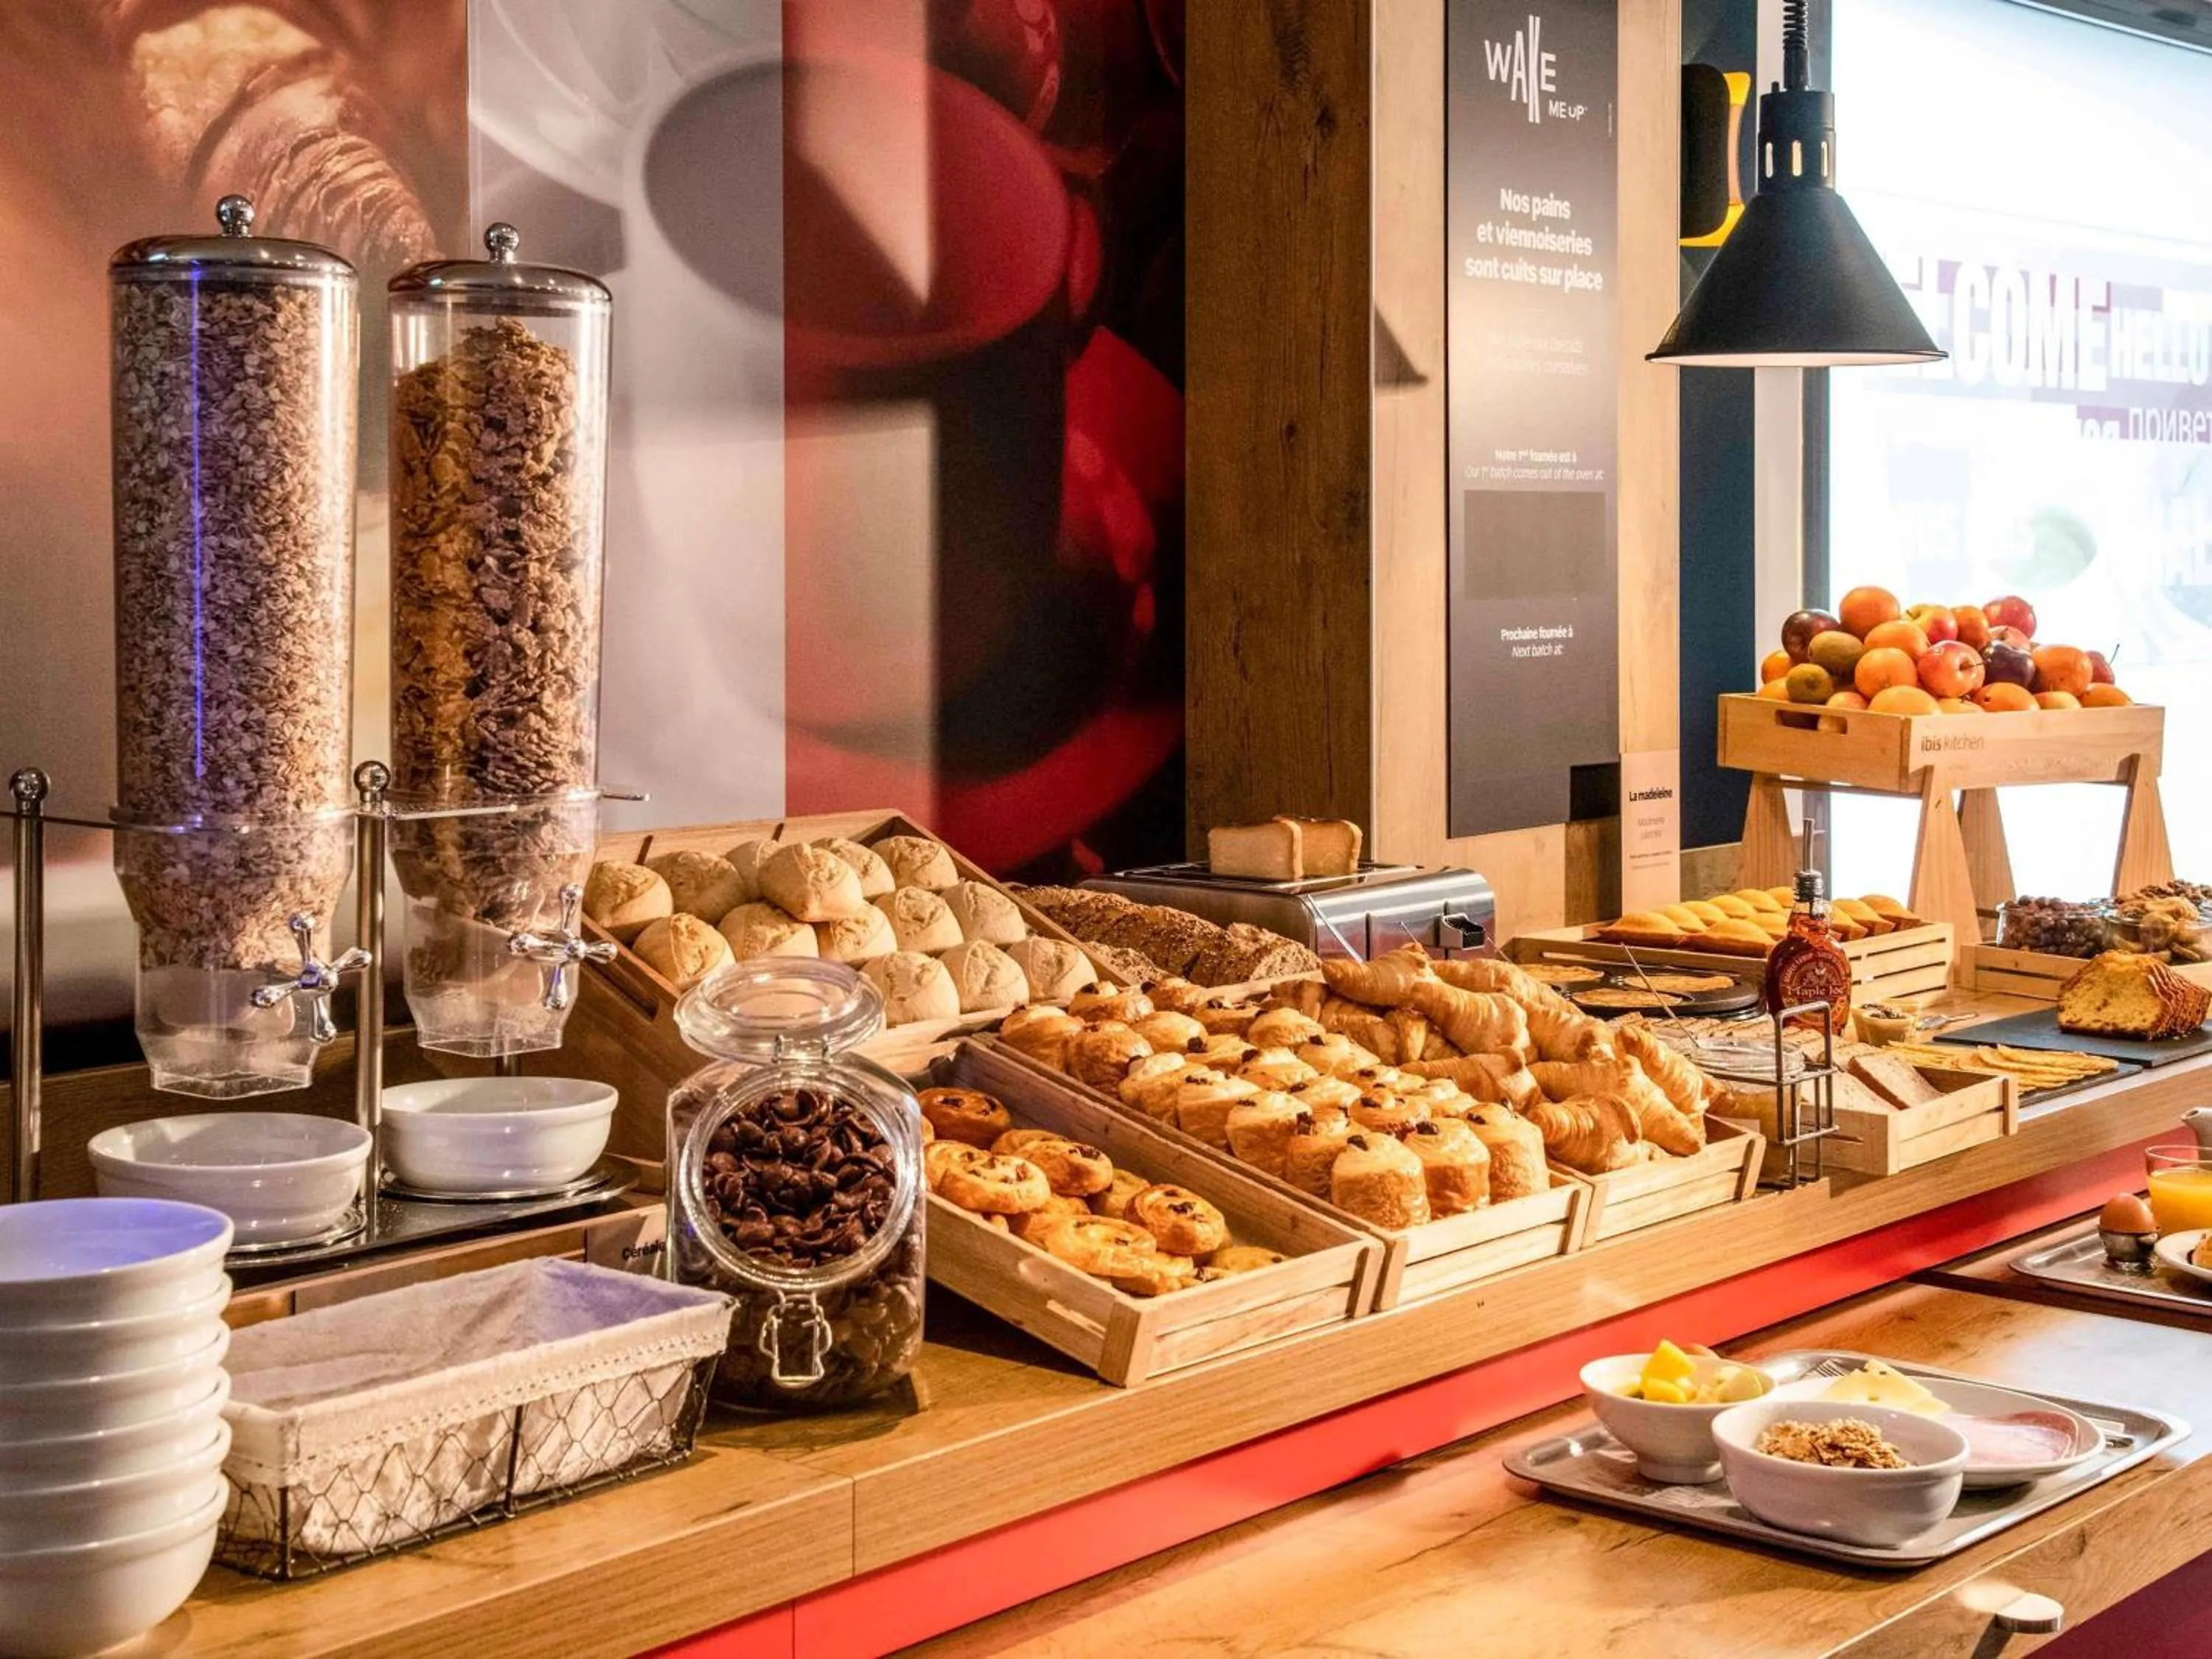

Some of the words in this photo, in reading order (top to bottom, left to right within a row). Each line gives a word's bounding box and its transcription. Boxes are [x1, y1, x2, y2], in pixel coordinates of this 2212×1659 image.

[1484, 15, 1557, 124] WAKE
[1548, 99, 1567, 119] ME
[1500, 188, 1531, 214] Nos
[1531, 192, 1571, 221] pains
[1477, 221, 1494, 244] et
[1495, 220, 1592, 256] viennoiseries
[1465, 257, 1500, 279] sont
[1501, 258, 1537, 284] cuits
[1539, 265, 1564, 286] sur
[1564, 263, 1604, 293] place
[1901, 255, 2107, 392] LCOME
[2110, 307, 2209, 386] HELLO
[1500, 626, 1538, 641] Prochaine
[1539, 625, 1568, 639] fournée
[1512, 644, 1531, 658] Next
[1531, 643, 1554, 657] batch
[1921, 736, 1941, 752] ibis
[1629, 790, 1638, 801] La
[1638, 787, 1673, 801] madeleine
[1787, 985, 1827, 999] Maple
